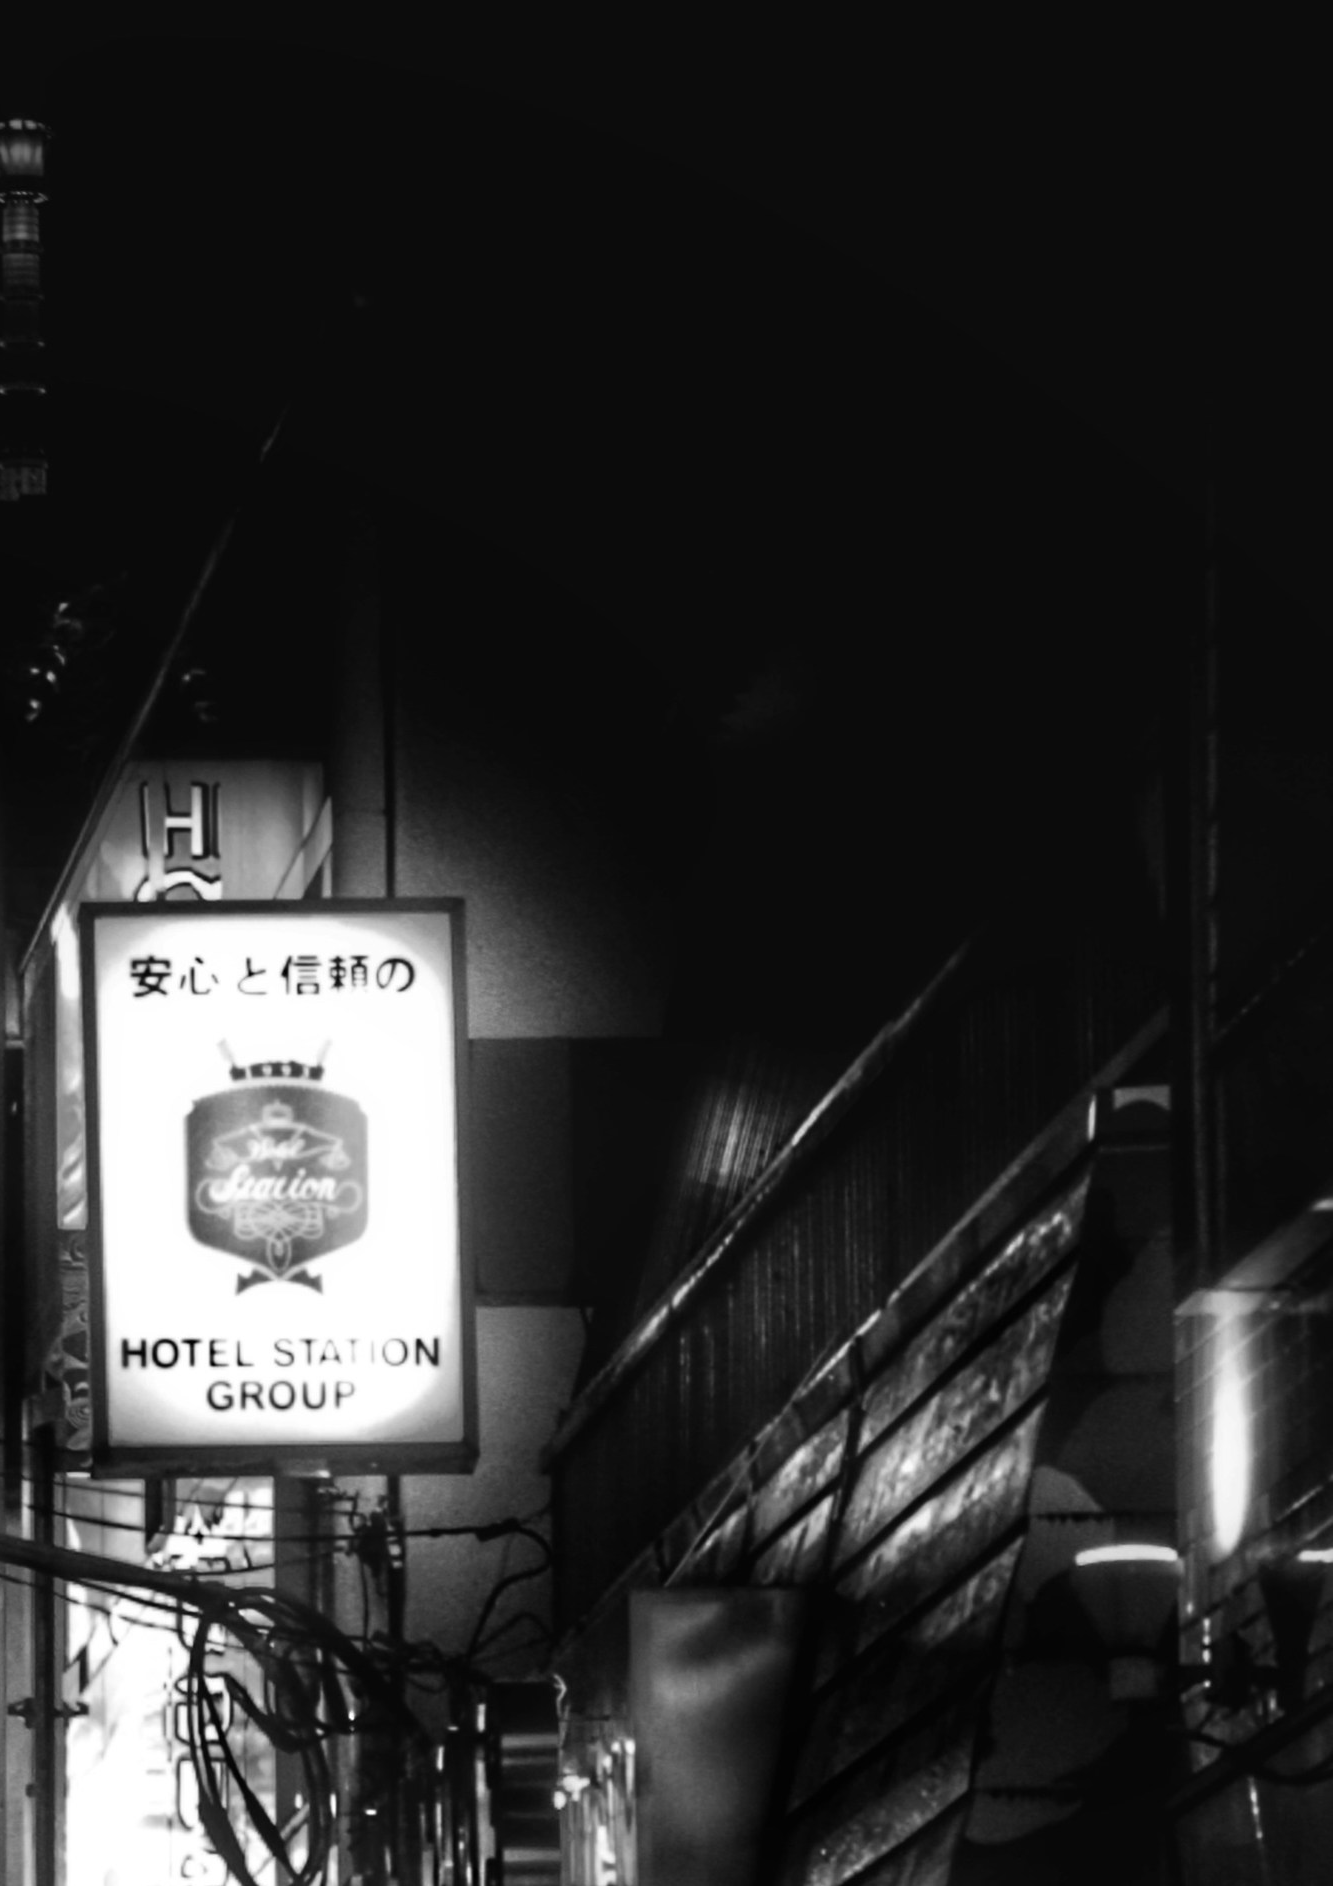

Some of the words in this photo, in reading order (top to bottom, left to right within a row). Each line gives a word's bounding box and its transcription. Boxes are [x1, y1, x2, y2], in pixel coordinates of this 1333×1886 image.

[129, 954, 416, 997] 安心と信頼の
[119, 1337, 255, 1369] HOTEL
[273, 1336, 441, 1369] STATION
[206, 1379, 357, 1412] GROUP
